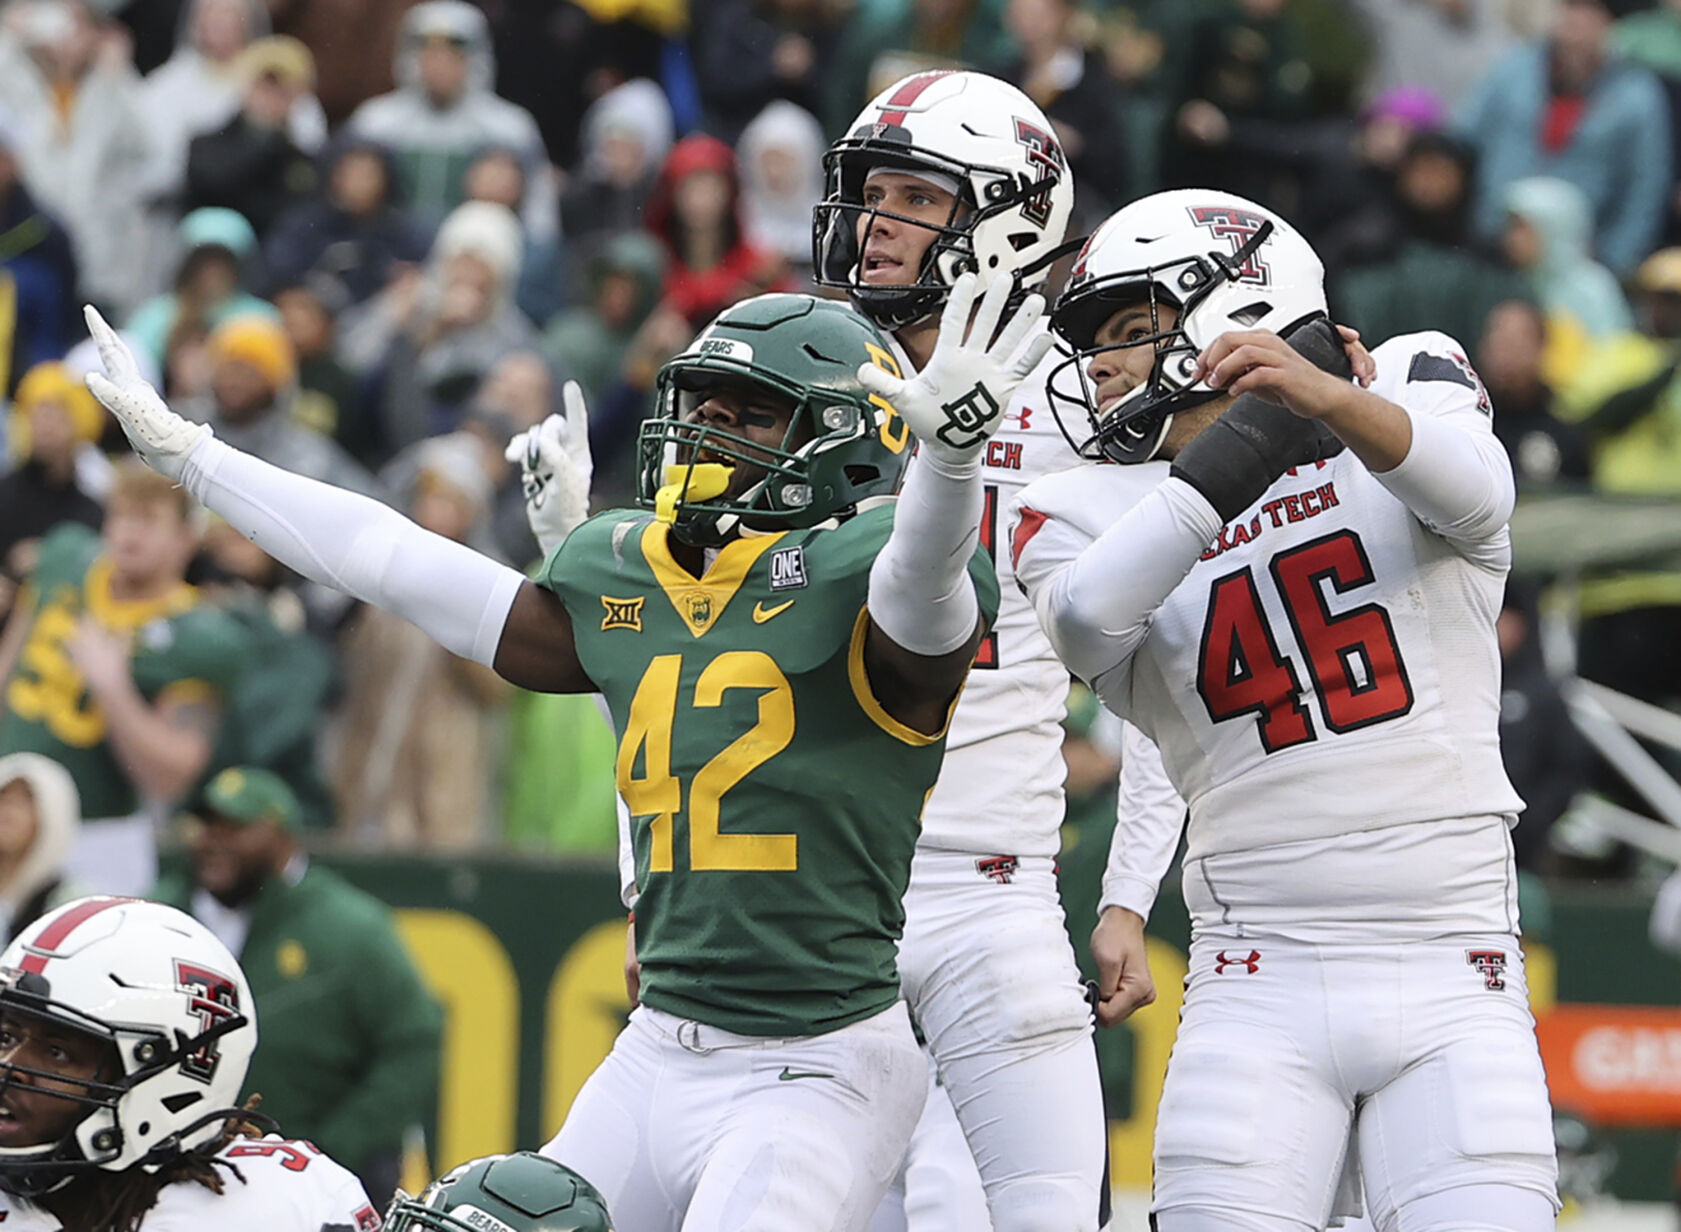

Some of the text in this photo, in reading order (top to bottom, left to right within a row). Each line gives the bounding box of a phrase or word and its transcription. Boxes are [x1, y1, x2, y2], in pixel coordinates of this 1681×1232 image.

[700, 340, 735, 355] BEARS
[1261, 481, 1340, 528] TECH
[772, 550, 801, 580] ONE
[1196, 528, 1415, 755] 46
[616, 650, 798, 873] 42
